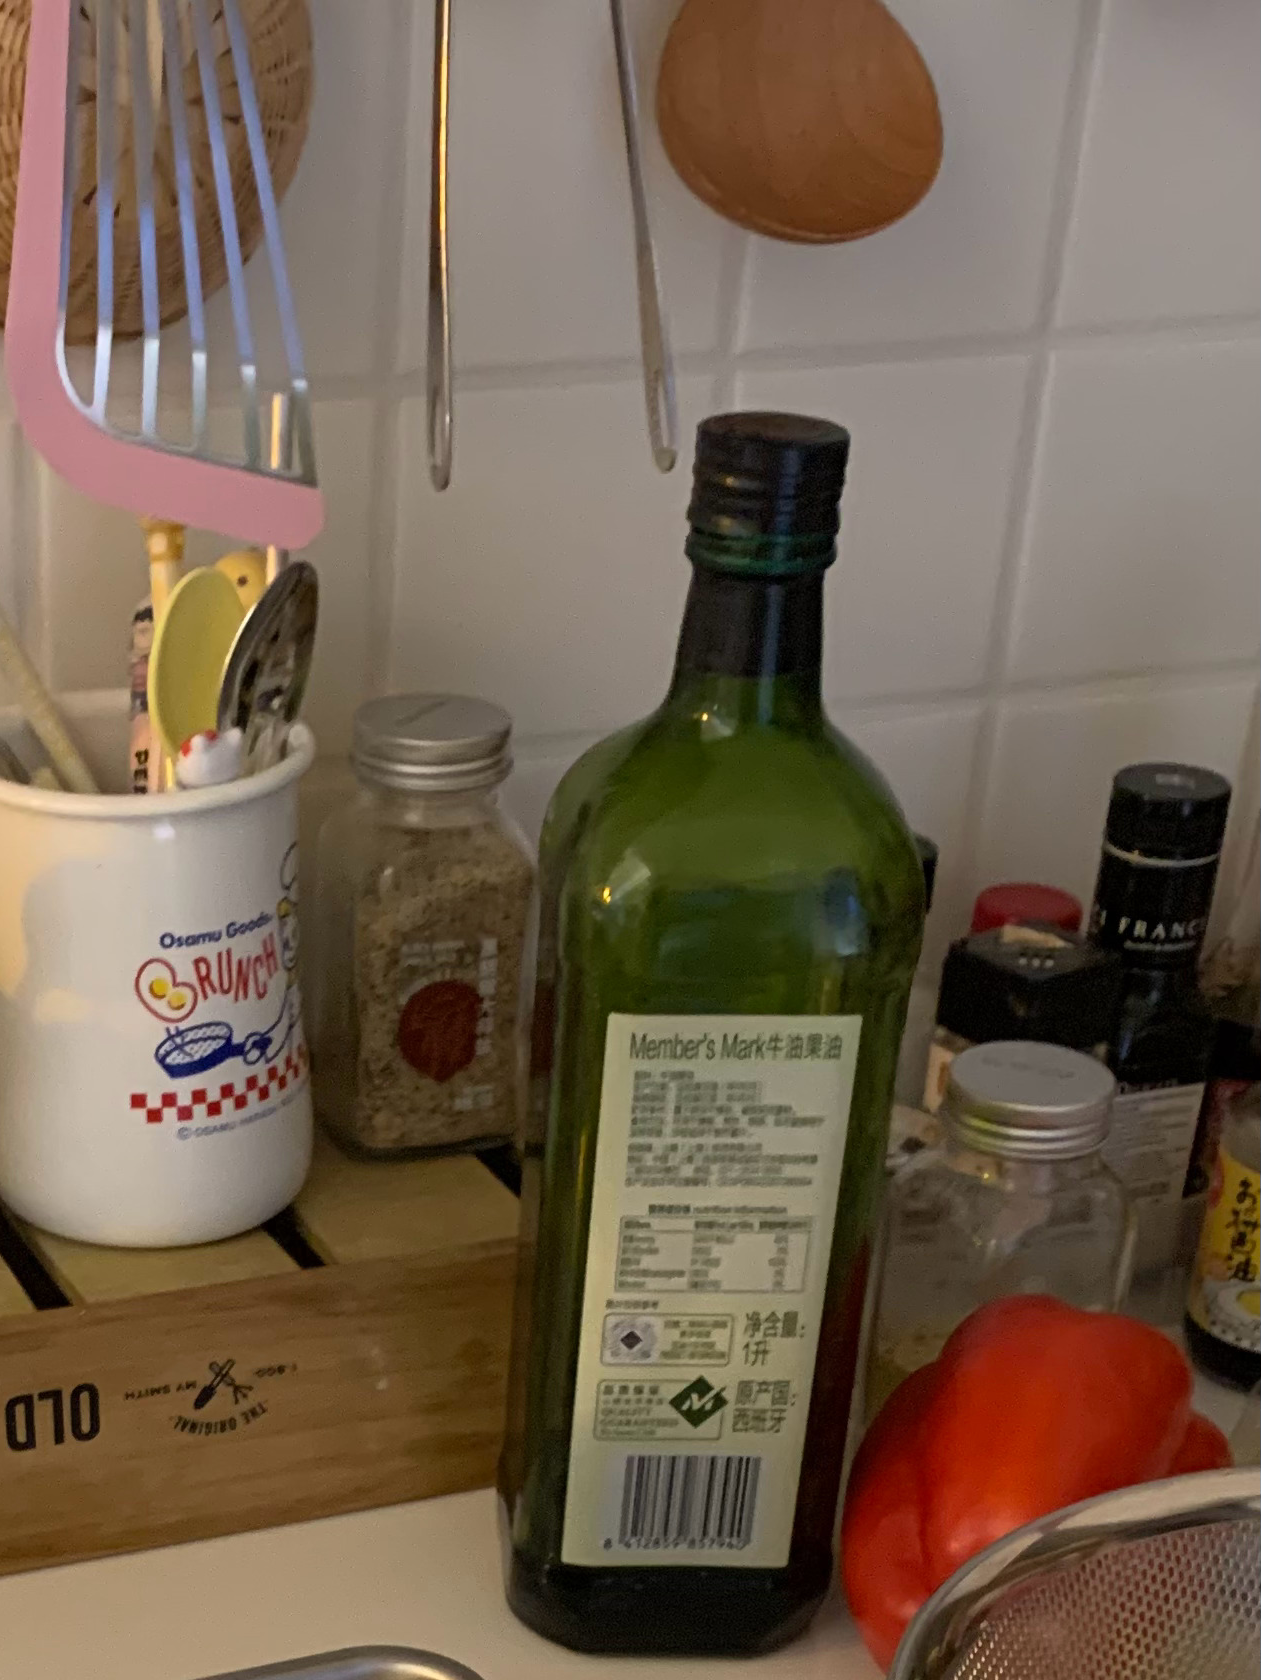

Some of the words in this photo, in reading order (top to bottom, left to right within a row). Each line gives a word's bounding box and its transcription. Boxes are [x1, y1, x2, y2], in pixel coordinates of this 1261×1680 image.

[159, 929, 222, 949] Osamu
[226, 912, 275, 938] Goods
[630, 1032, 716, 1060] Member's
[124, 1384, 171, 1401] SMITH
[176, 1380, 197, 1393] MY
[4, 1383, 101, 1452] OLD
[241, 1401, 268, 1425] THE
[173, 1415, 237, 1436] ORIGINAL
